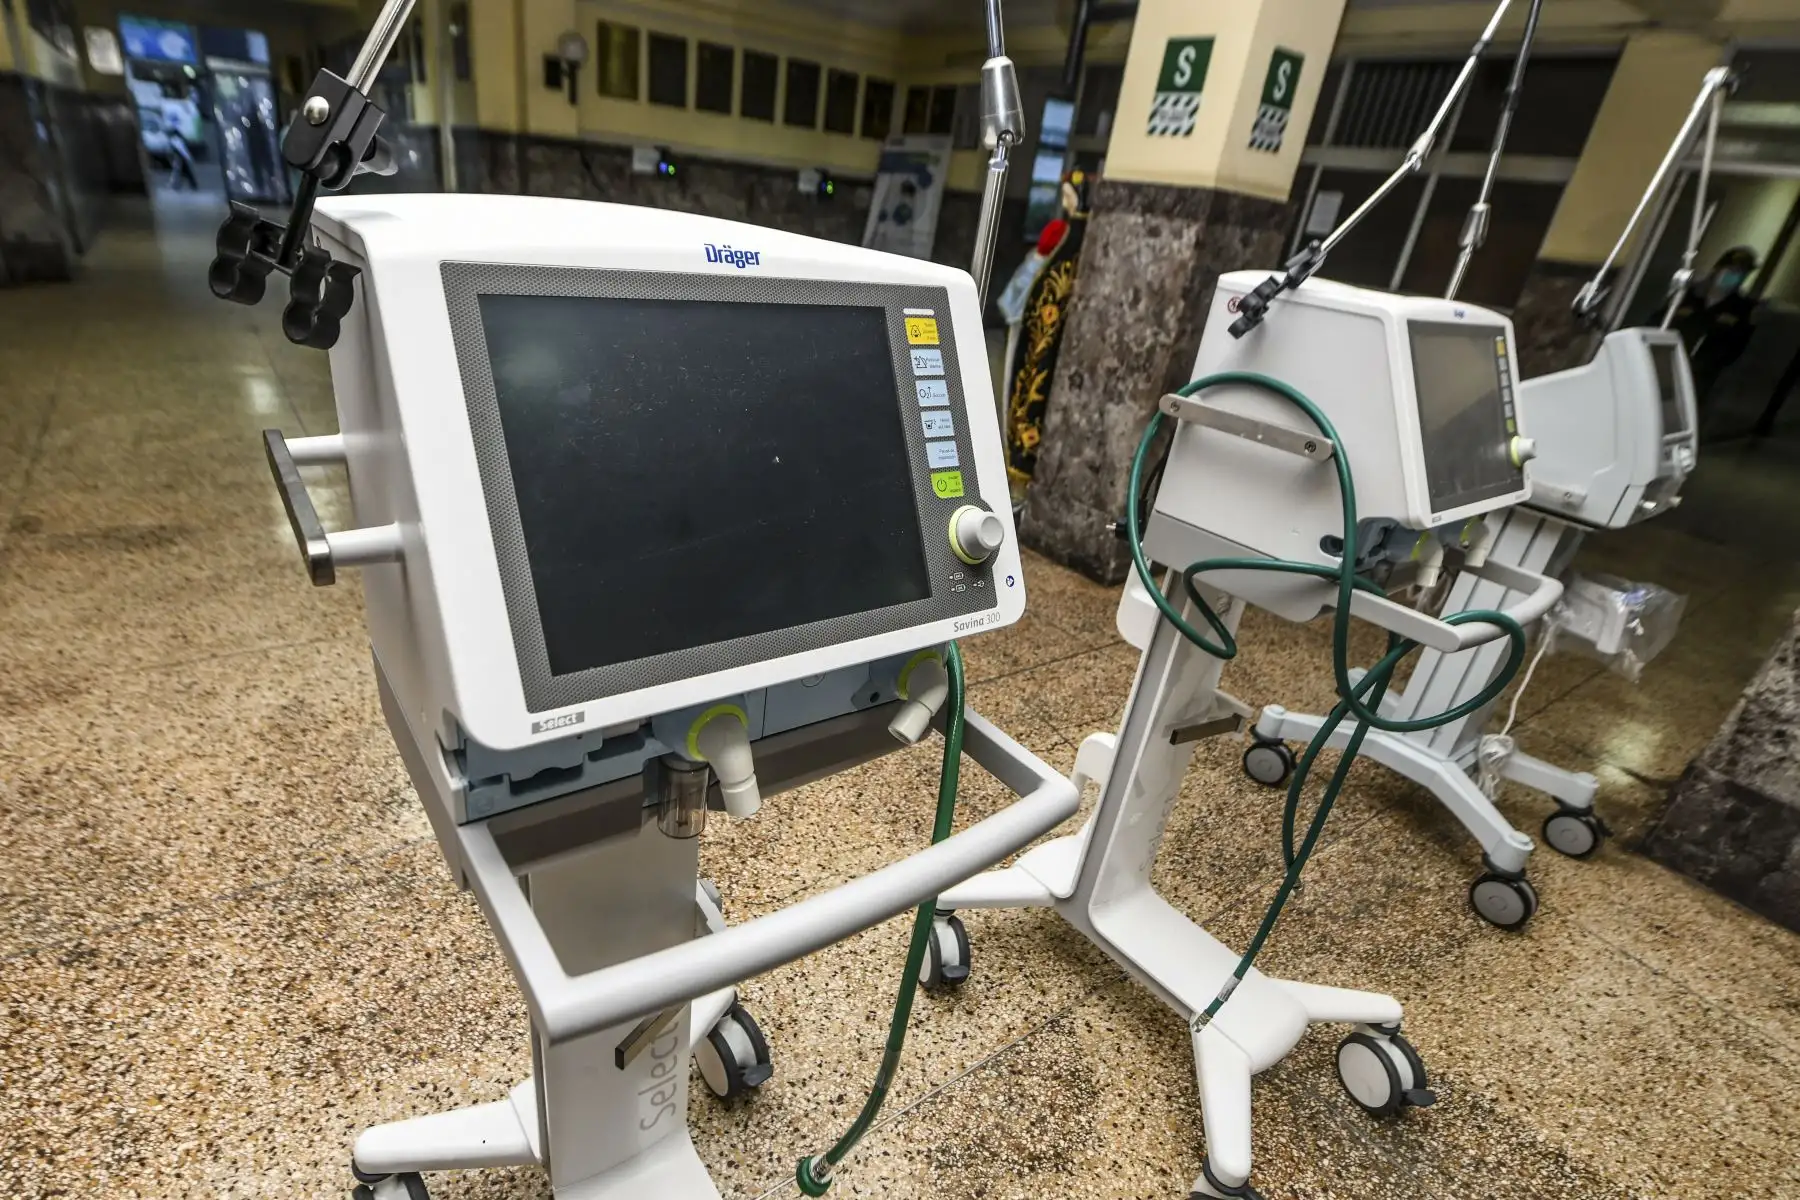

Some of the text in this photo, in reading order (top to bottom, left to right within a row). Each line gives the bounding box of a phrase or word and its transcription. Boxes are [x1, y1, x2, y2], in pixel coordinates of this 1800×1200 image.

[1173, 44, 1197, 88] S
[1272, 59, 1292, 102] S
[703, 243, 761, 269] Dräger
[953, 611, 1001, 632] Savina 300
[539, 713, 576, 731] Select
